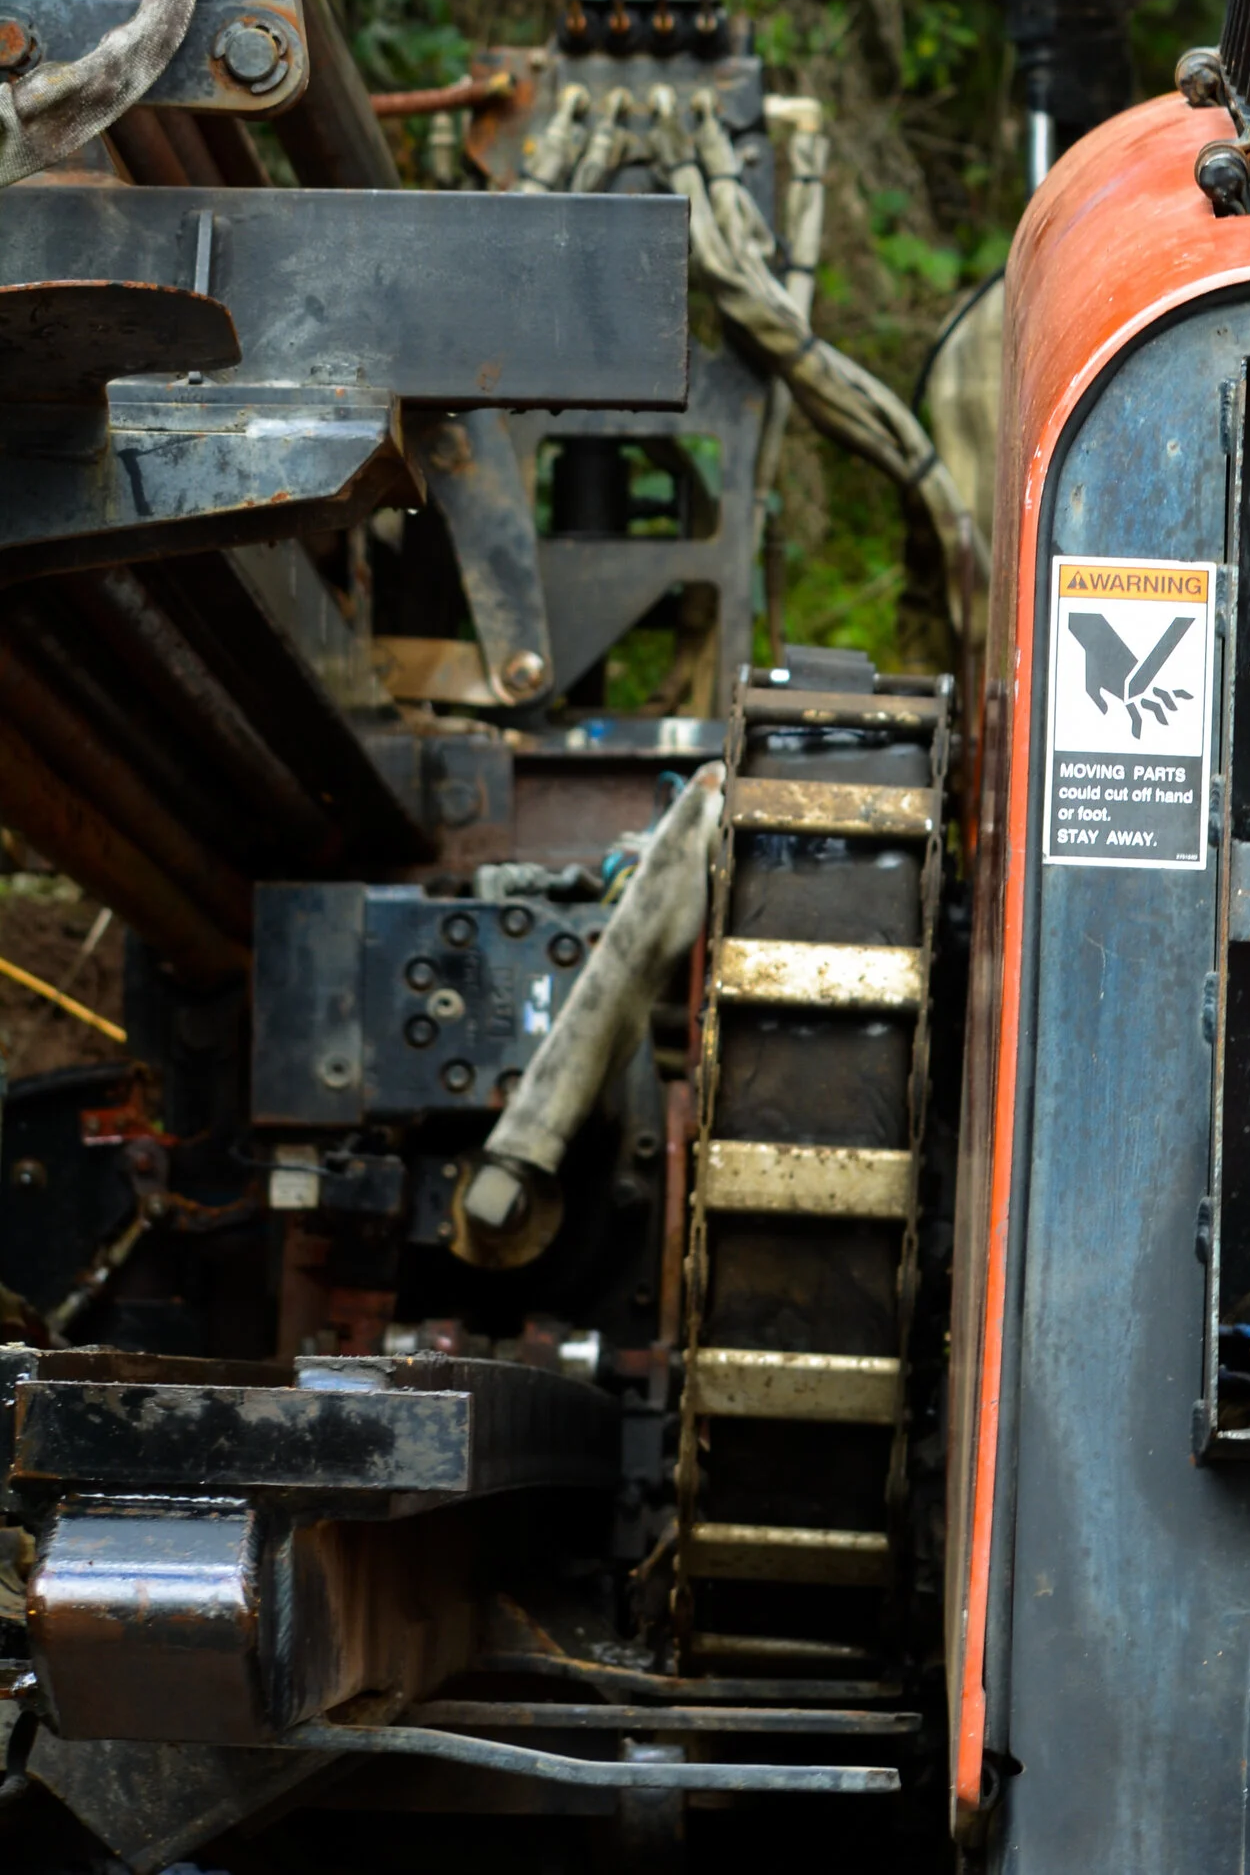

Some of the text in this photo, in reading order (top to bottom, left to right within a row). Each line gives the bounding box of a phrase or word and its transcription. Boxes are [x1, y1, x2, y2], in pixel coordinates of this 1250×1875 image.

[1089, 572, 1202, 596] WARNING
[1060, 763, 1186, 782] MOVING PARTS
[1058, 785, 1194, 803] could cut off hand
[1057, 805, 1111, 822] or foot.
[1057, 828, 1158, 847] STAY AWAY.
